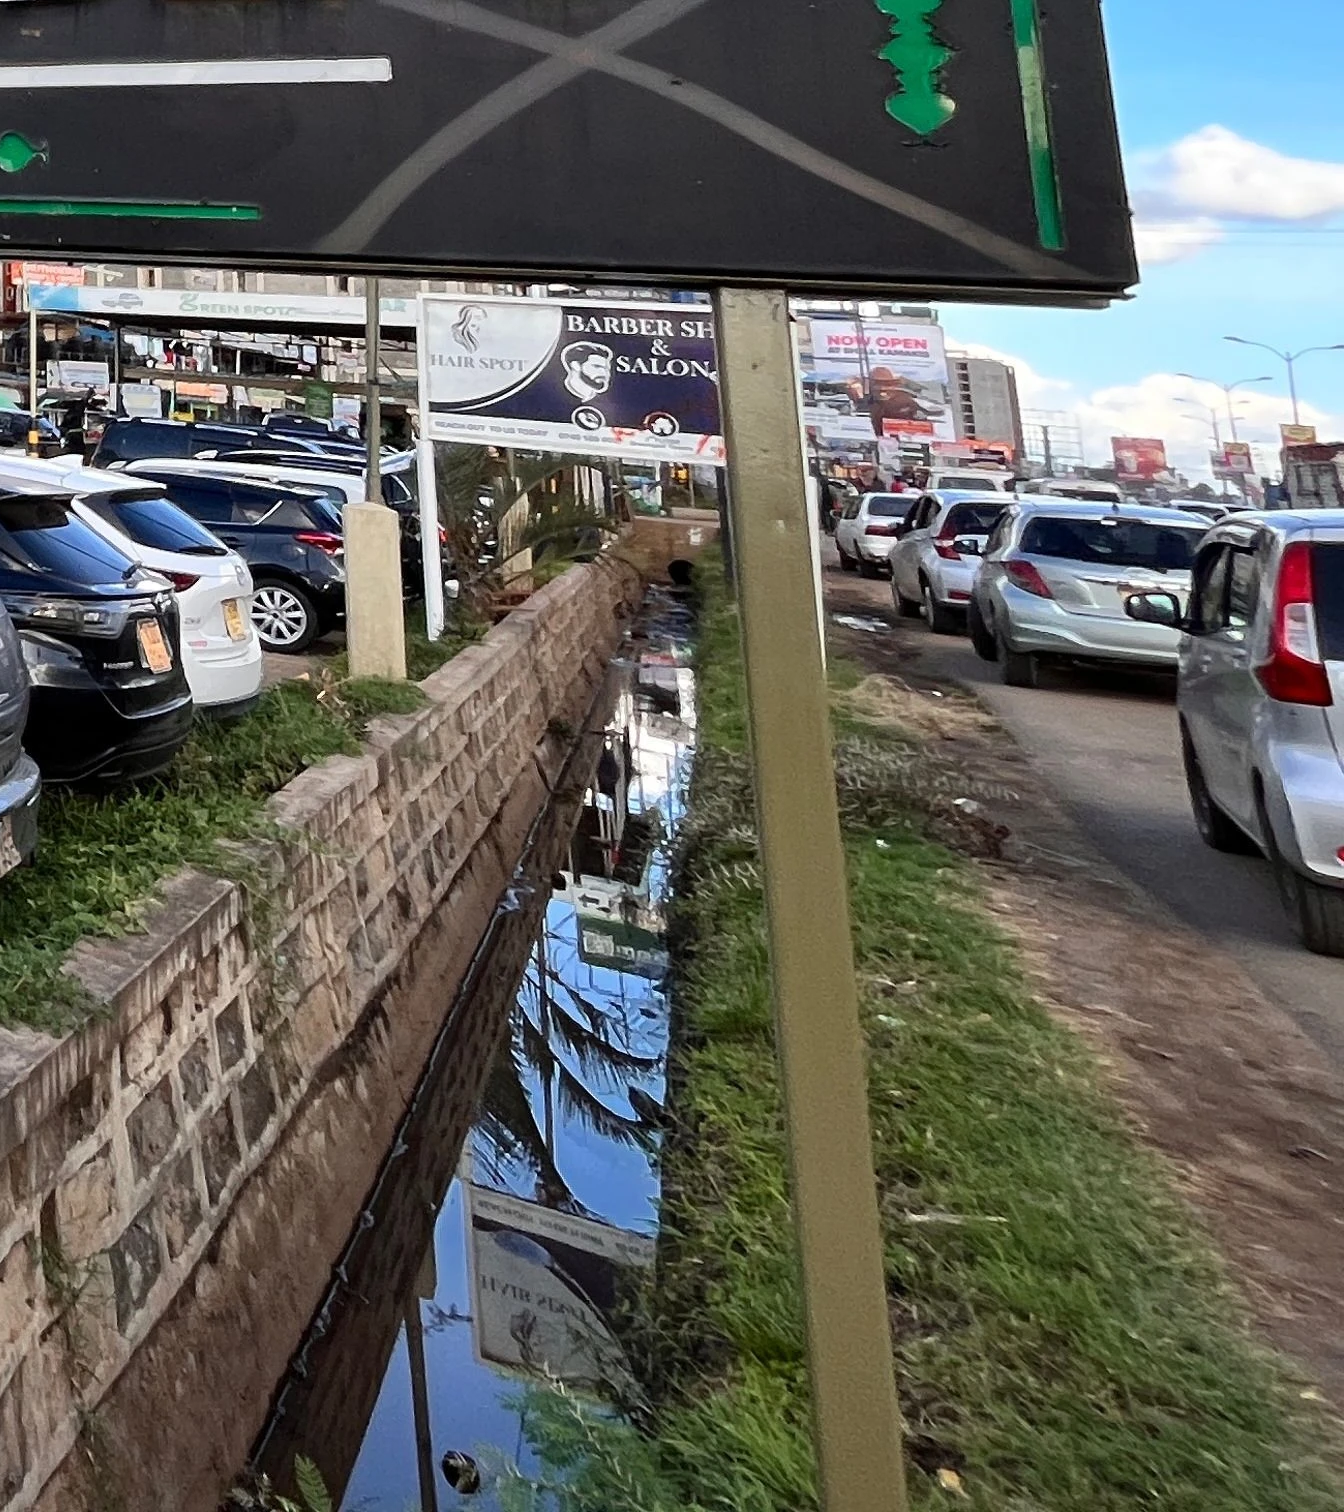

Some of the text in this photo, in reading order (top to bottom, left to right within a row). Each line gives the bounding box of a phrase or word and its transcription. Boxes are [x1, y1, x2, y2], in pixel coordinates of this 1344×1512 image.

[567, 314, 674, 337] BARBER
[650, 338, 672, 356] &
[826, 335, 928, 350] NOW OPEN
[431, 353, 528, 372] HAIR SPOT
[616, 356, 710, 378] SALON
